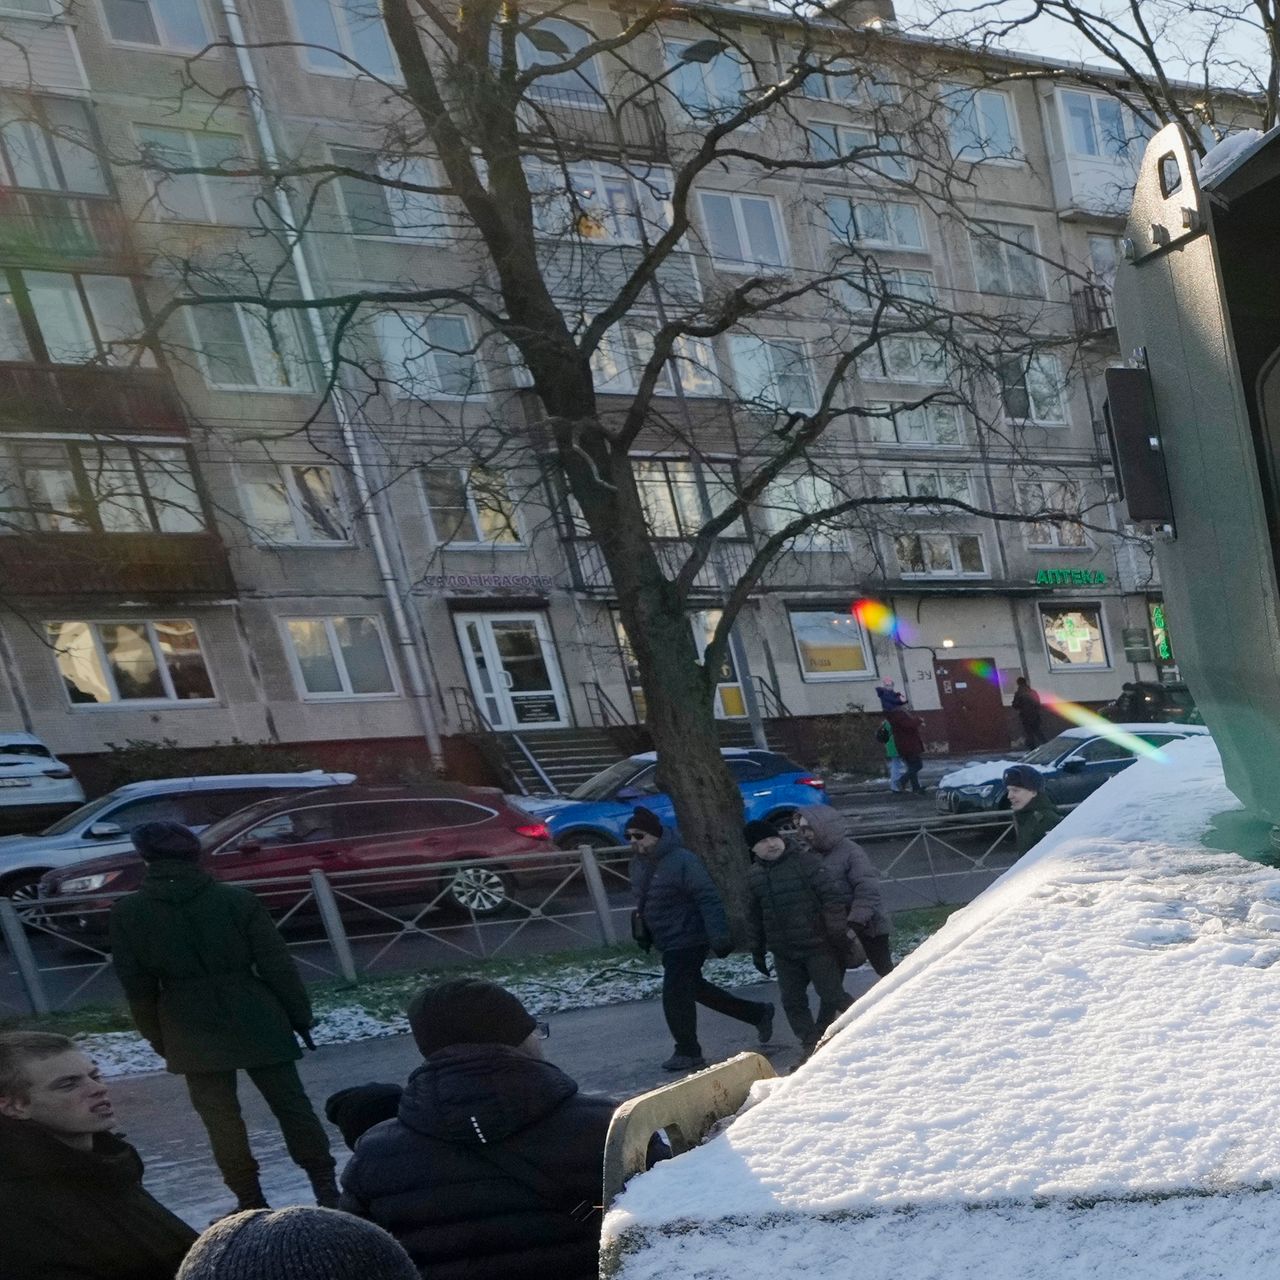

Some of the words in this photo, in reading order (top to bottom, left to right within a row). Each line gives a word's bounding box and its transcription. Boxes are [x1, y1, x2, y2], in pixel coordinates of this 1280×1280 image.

[425, 575, 479, 587] САЛОН
[480, 575, 552, 587] КРАСОТЫ
[1037, 569, 1105, 584] АПТЕКА
